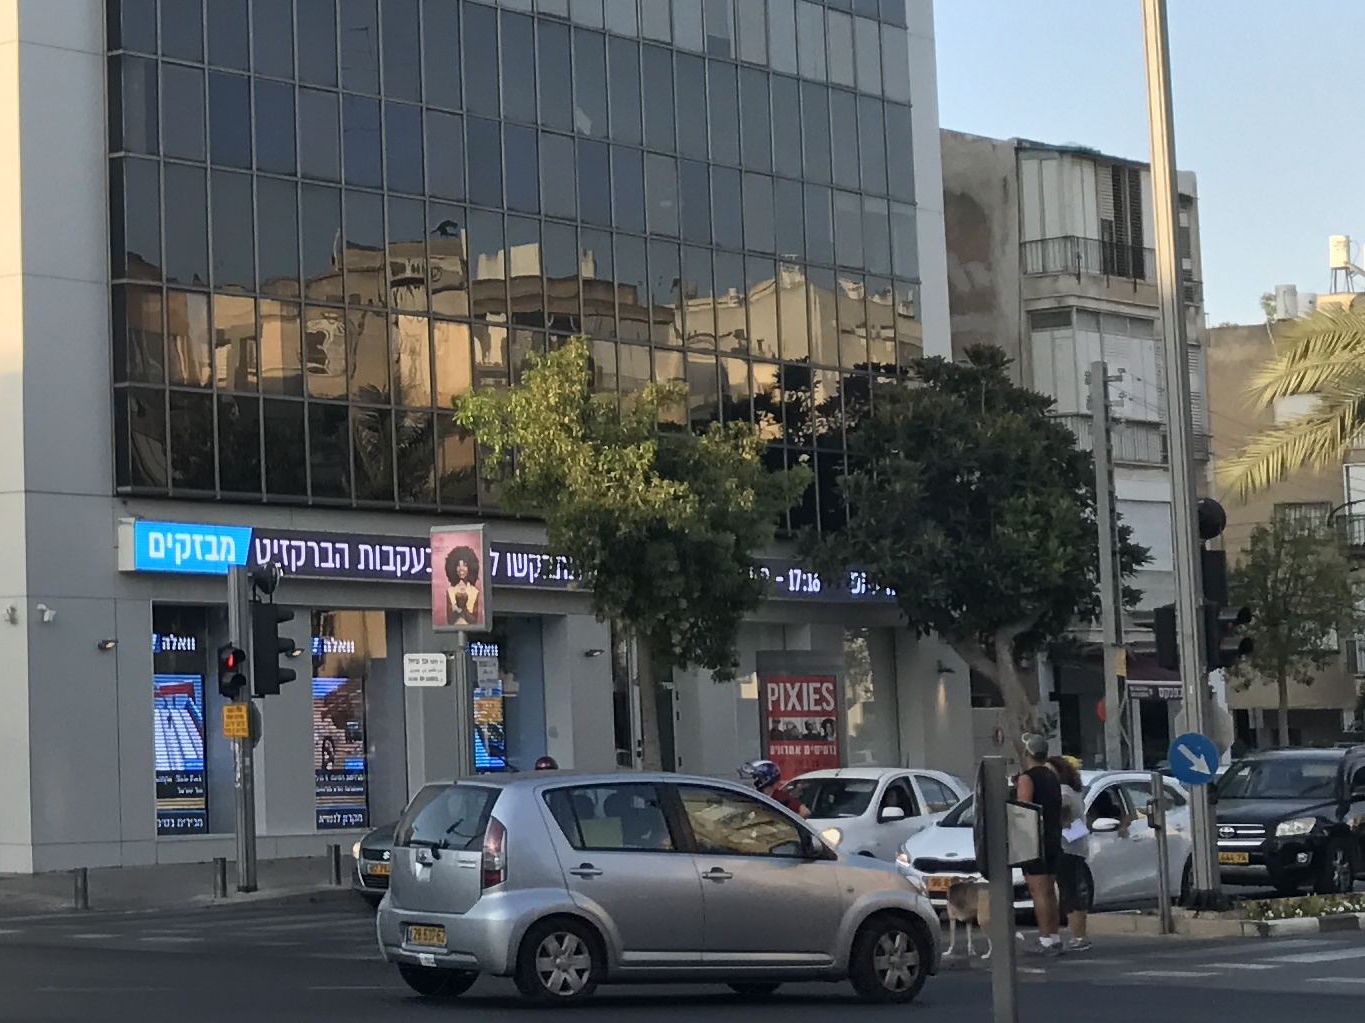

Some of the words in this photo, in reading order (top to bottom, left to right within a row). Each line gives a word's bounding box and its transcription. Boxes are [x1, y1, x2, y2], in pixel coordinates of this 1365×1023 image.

[148, 531, 236, 566] מבזקים
[255, 538, 349, 573] הברקזיט
[789, 569, 821, 592] 17:16
[162, 634, 196, 652] וואלה
[323, 635, 355, 654] וואלה
[767, 682, 835, 711] PIXIES
